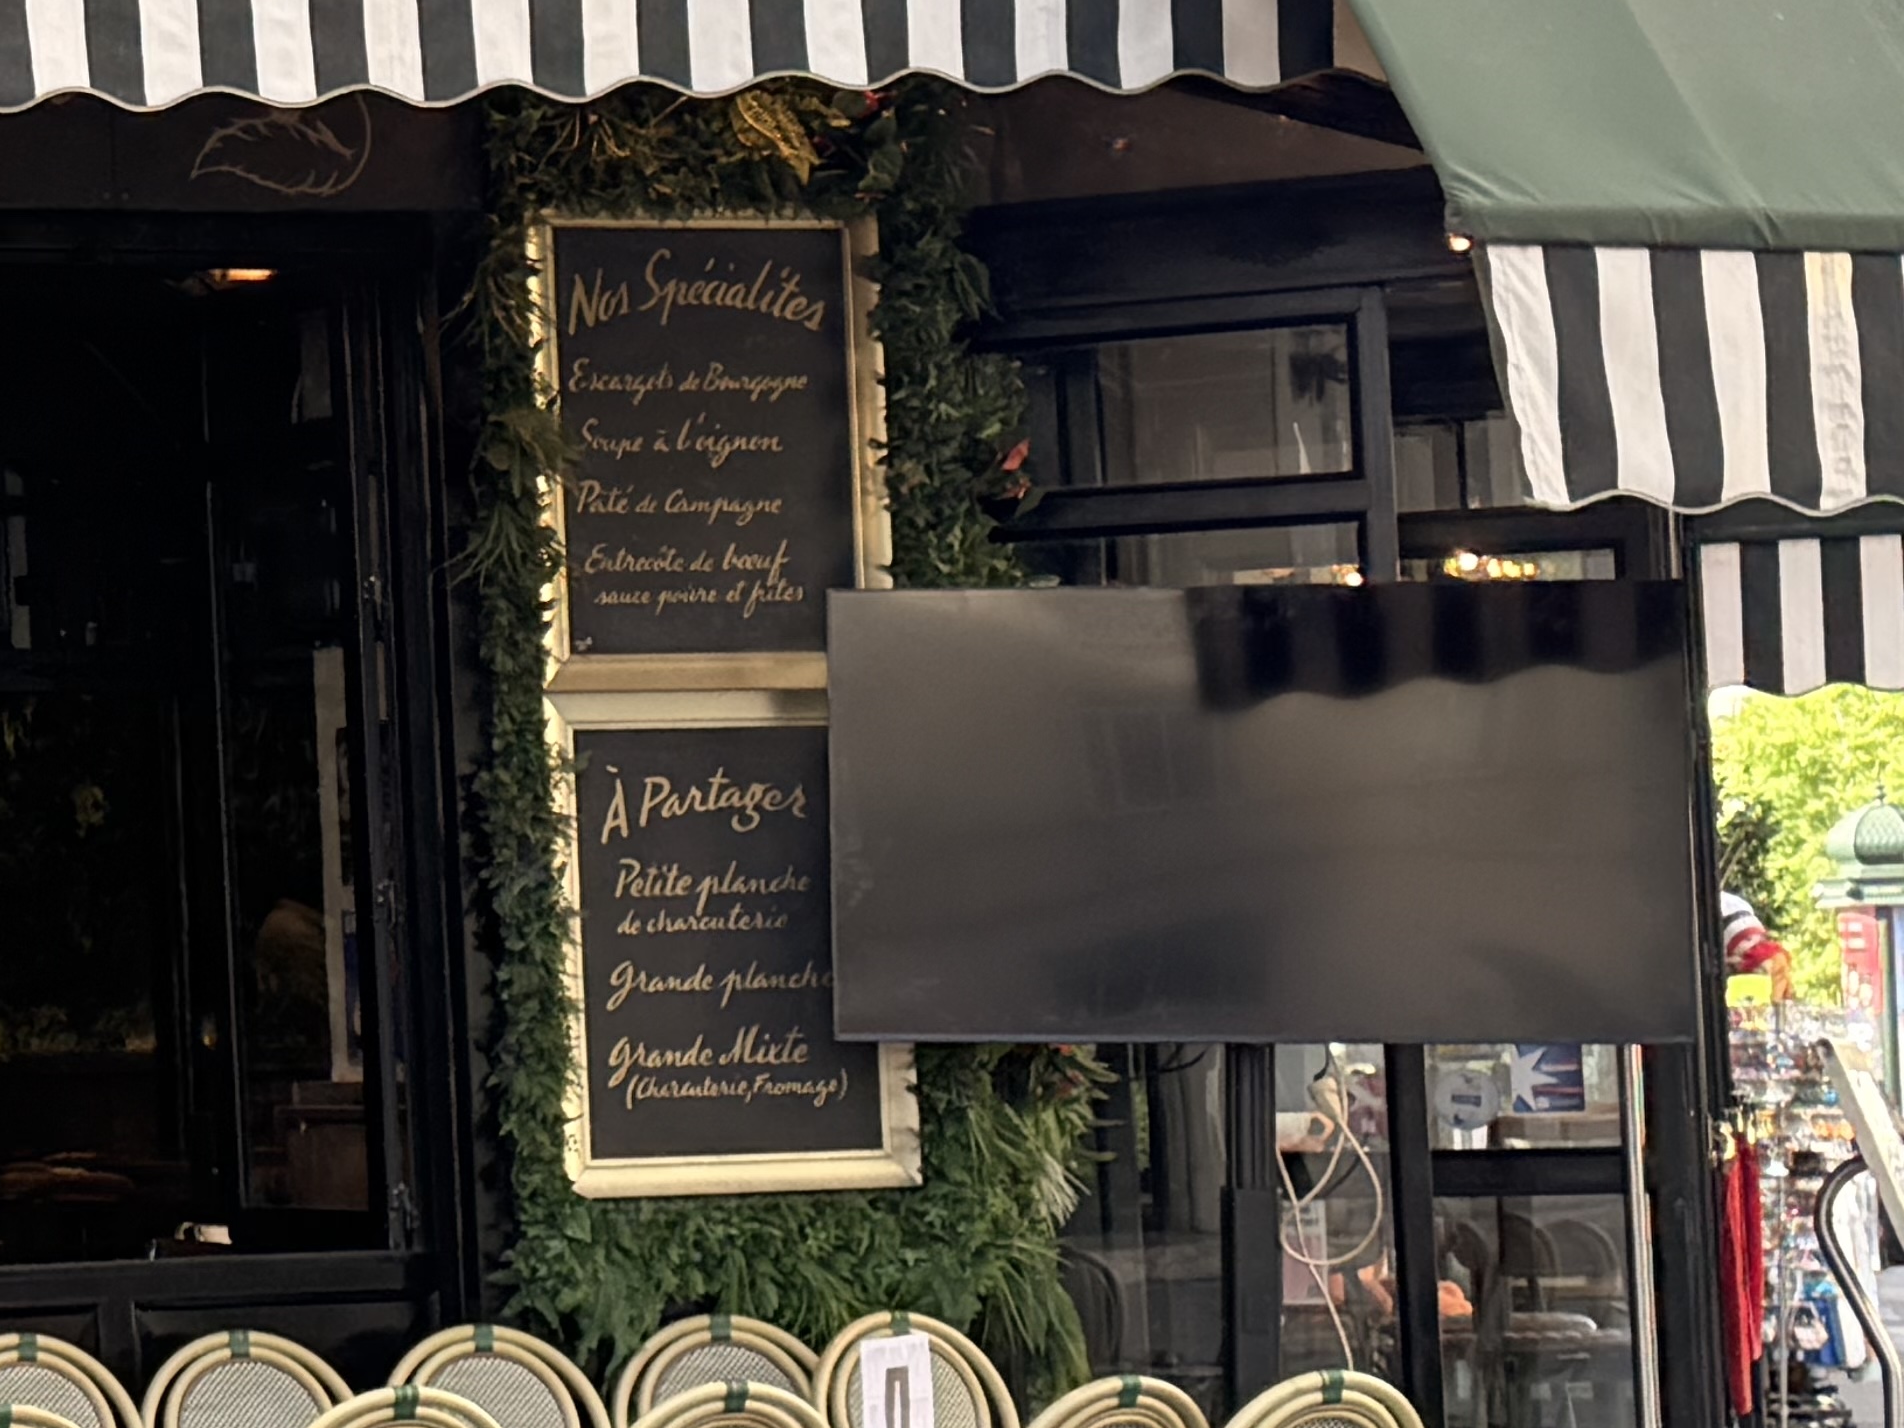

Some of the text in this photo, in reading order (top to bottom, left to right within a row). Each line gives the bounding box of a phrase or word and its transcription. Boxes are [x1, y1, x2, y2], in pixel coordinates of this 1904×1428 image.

[569, 268, 629, 336] Nos
[569, 358, 808, 406] Escargots de Bourgogne
[582, 412, 784, 469] Soupe à l'oignon
[635, 493, 658, 514] de
[664, 488, 784, 526] Campagne
[584, 543, 685, 574] Entrecôte
[689, 550, 715, 572] de
[594, 578, 805, 619] sauce poivre et frites
[601, 763, 808, 845] À Partager
[615, 858, 812, 917] Petite planche
[617, 902, 789, 935] de charcuterie
[606, 960, 714, 1011] Grande
[608, 1024, 810, 1088] Grande Mixte
